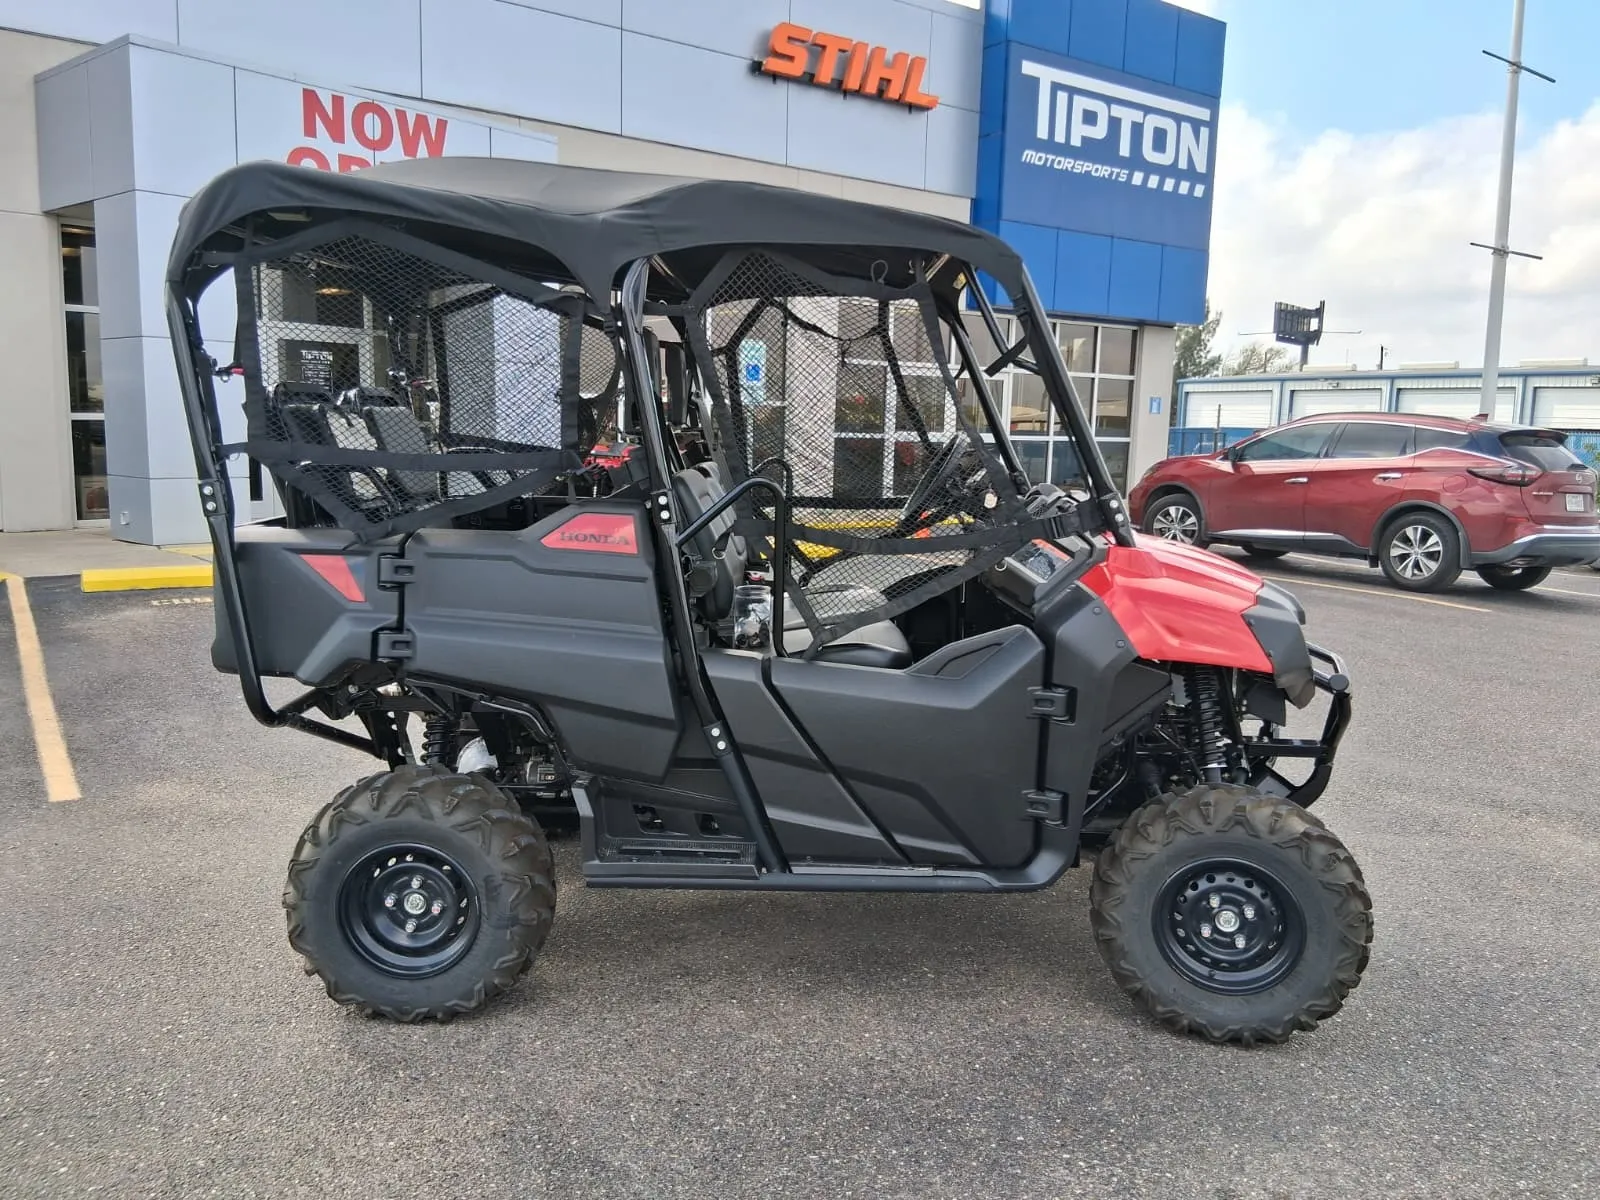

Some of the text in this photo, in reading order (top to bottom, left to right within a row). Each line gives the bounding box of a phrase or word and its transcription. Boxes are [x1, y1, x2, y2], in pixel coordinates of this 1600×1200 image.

[763, 22, 939, 109] STIHL
[302, 87, 448, 158] NOW
[1021, 60, 1211, 173] TIPTON
[1021, 149, 1129, 182] MOTORSPORTS
